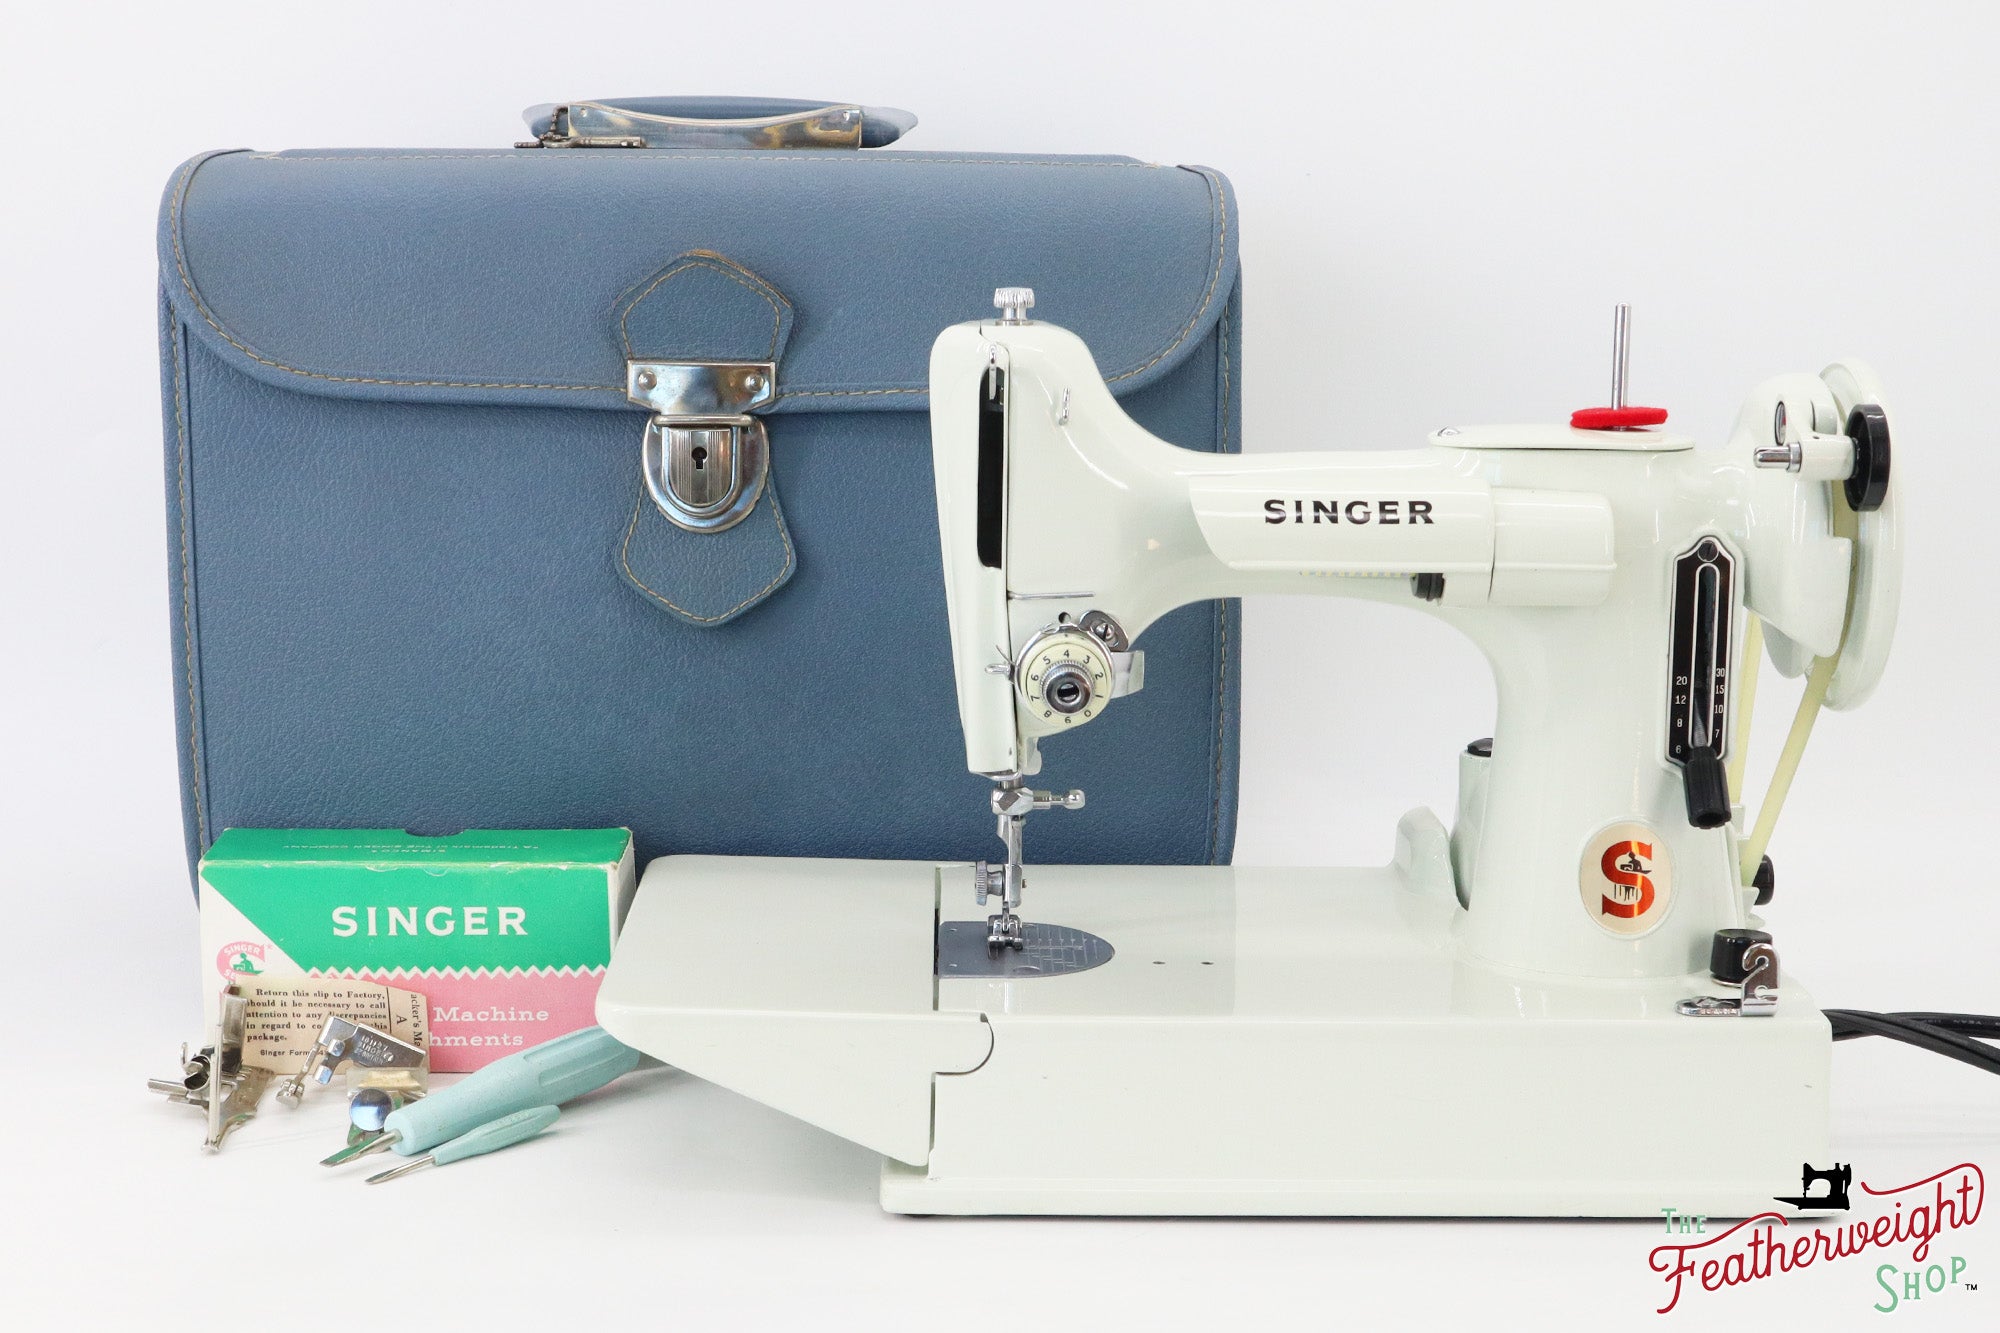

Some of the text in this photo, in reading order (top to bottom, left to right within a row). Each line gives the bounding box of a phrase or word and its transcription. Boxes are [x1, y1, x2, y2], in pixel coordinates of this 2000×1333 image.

[1264, 499, 1435, 525] SINGER
[1063, 649, 1070, 658] 4
[1042, 656, 1051, 665] 5
[1083, 655, 1091, 664] 3
[1094, 671, 1104, 680] 2
[1716, 668, 1725, 677] 30
[1676, 676, 1688, 686] 20
[1715, 685, 1724, 694] 15
[1675, 695, 1687, 705] 12
[1043, 710, 1052, 718] 8
[1083, 710, 1092, 718] 0
[1714, 705, 1723, 714] 10
[1677, 718, 1683, 728] 8
[1715, 729, 1720, 738] 7
[1675, 745, 1681, 754] 6
[331, 905, 529, 937] SINGER
[223, 943, 260, 956] SINGER
[256, 988, 288, 997] Return
[292, 989, 309, 997] this
[313, 990, 329, 999] slip
[347, 991, 385, 1000] Factory,
[280, 999, 287, 1007] it
[307, 1001, 351, 1010] necessary
[306, 1012, 322, 1020] any
[433, 1006, 549, 1022] Machine
[396, 1015, 408, 1025] A
[262, 1022, 291, 1031] regard
[247, 1033, 287, 1043] package.
